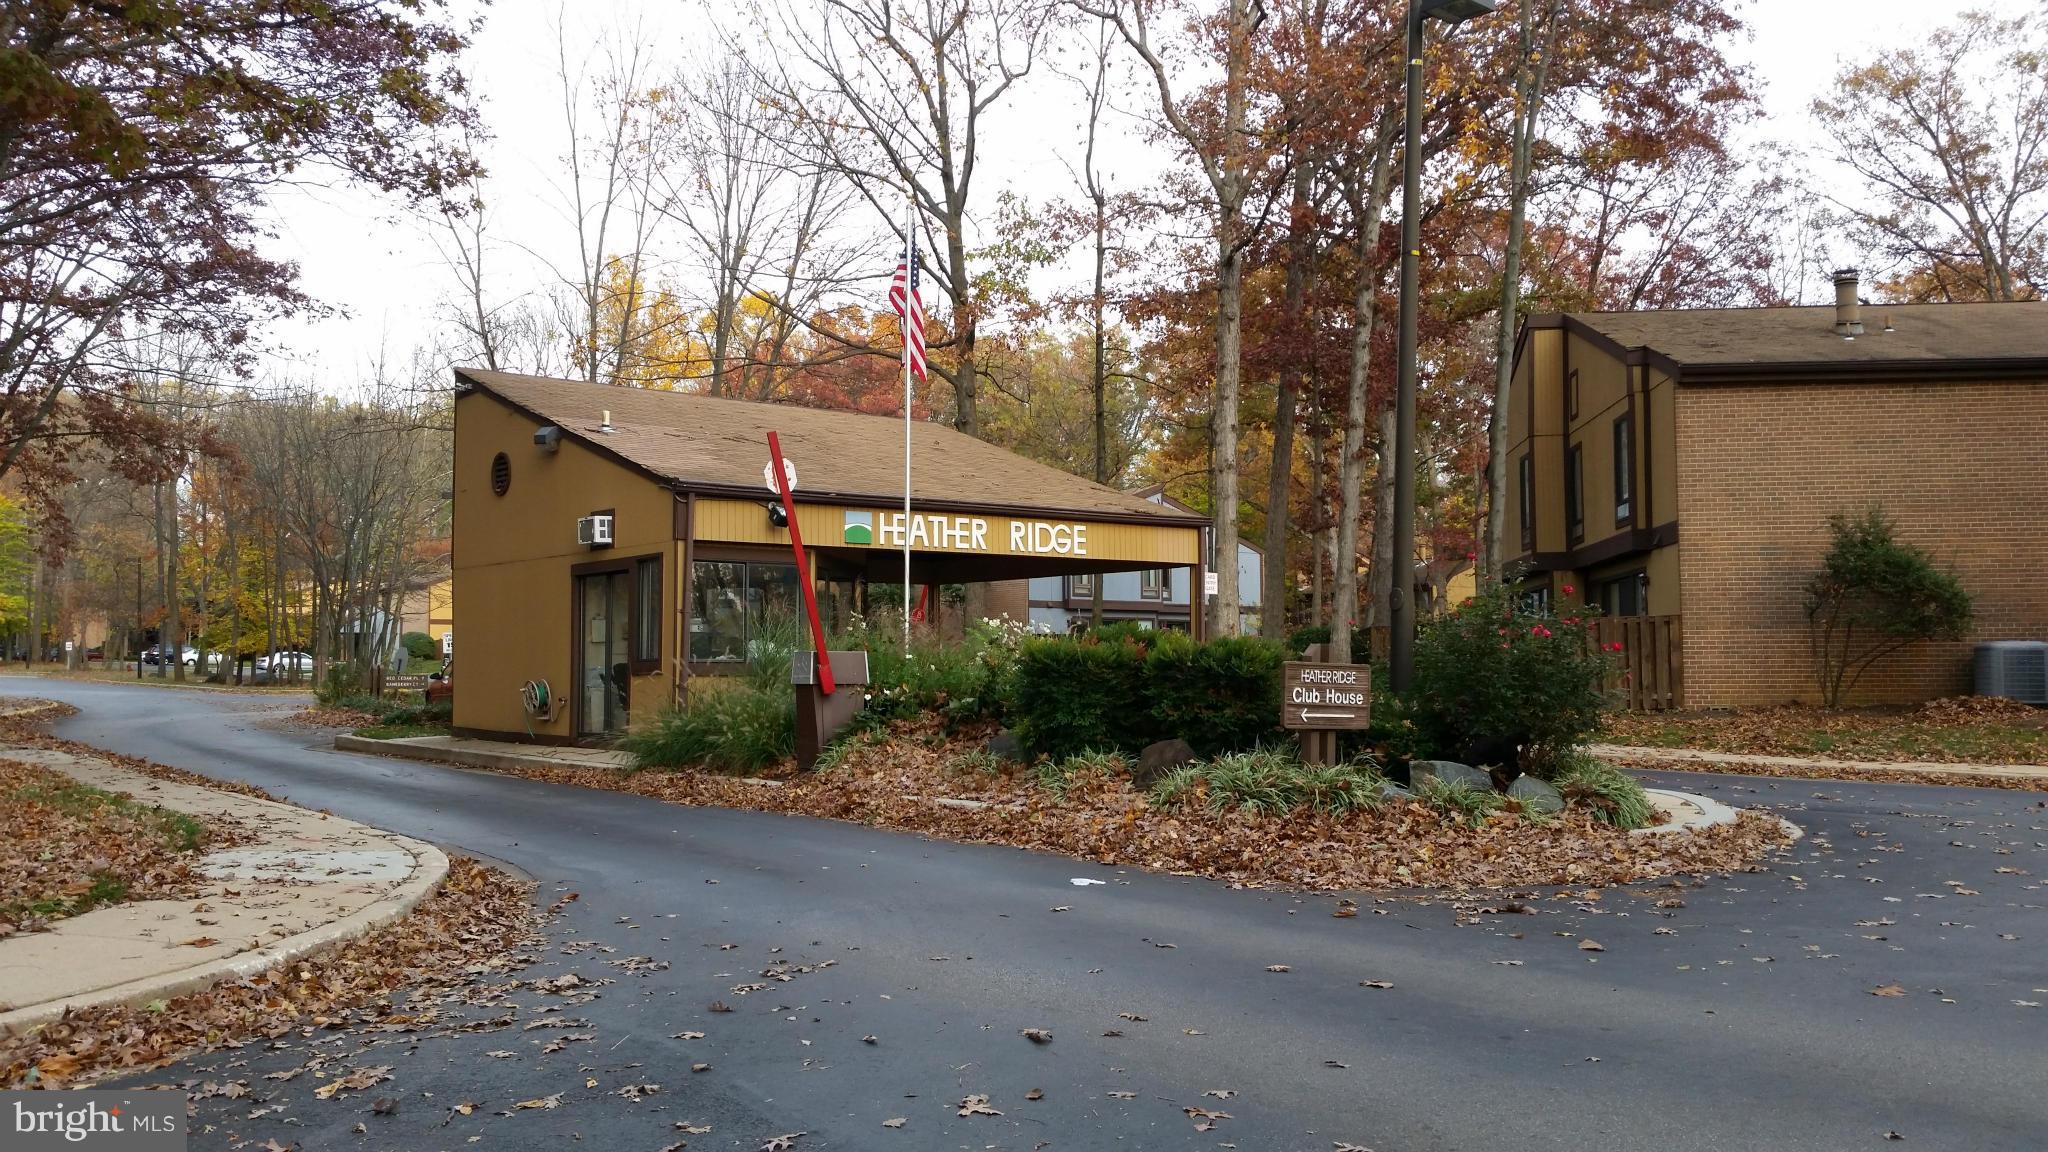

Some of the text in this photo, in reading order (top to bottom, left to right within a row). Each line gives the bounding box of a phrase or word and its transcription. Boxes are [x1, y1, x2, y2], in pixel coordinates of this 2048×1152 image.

[879, 512, 1087, 555] HEATHER RIDGE
[1301, 669, 1356, 684] HEATHER RIDGE
[1292, 687, 1364, 705] Club House
